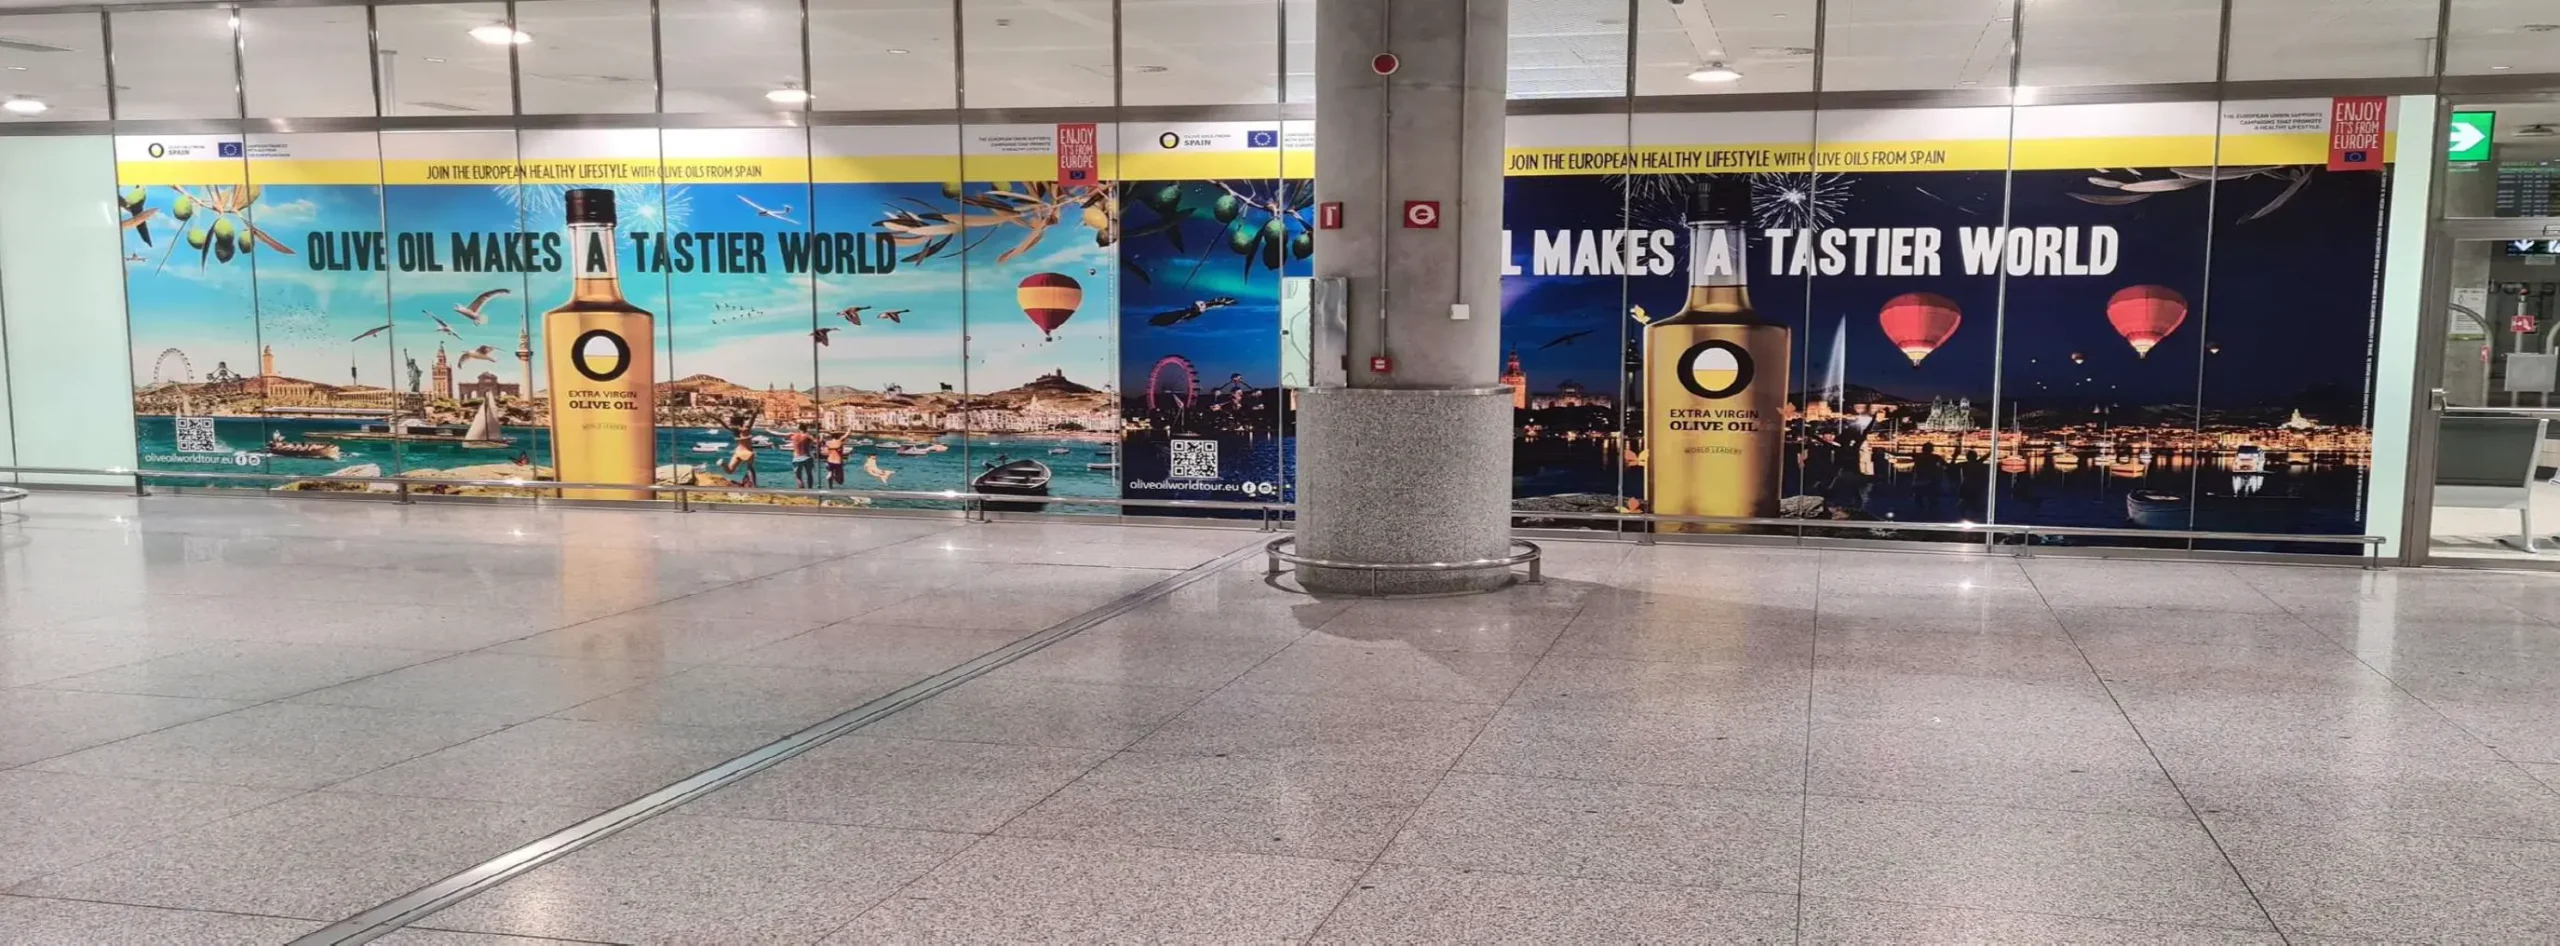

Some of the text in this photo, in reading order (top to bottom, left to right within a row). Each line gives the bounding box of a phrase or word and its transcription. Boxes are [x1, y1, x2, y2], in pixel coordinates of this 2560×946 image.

[2336, 101, 2383, 122] ENJOY
[2335, 121, 2380, 134] IT'S FROM
[1060, 127, 1094, 145] ENJOY
[2334, 134, 2379, 149] EUROPE
[1075, 144, 1093, 155] FROM
[1061, 155, 1094, 168] EUROPE
[1509, 150, 1945, 170] JOIN THE EUROPEAN HEALTHY LIFESTYLE WITH OLIVE OILS FROM SPAIN
[427, 164, 762, 179] JOIN THE EUROPEAN HEALTHY LIFESTYLE WITH OLIVE OILS FROM SPAIN
[307, 231, 897, 274] OLIVE OIL MAKES A TASTIER WORLD
[1533, 229, 1675, 276] MAKES
[1703, 229, 1733, 276] A
[1765, 227, 1941, 276] TASTIER
[1958, 225, 2119, 276] WORLD
[568, 390, 637, 399] EXTRA VIRGIN
[569, 400, 638, 410] OLIVE OIL
[1670, 408, 1759, 419] EXTRA VIRGIN
[1669, 421, 1758, 432] OLIVE OIL
[145, 453, 233, 464] oliveoilworldtour.eu
[1130, 478, 1239, 492] oliveoilworldtour.eu
